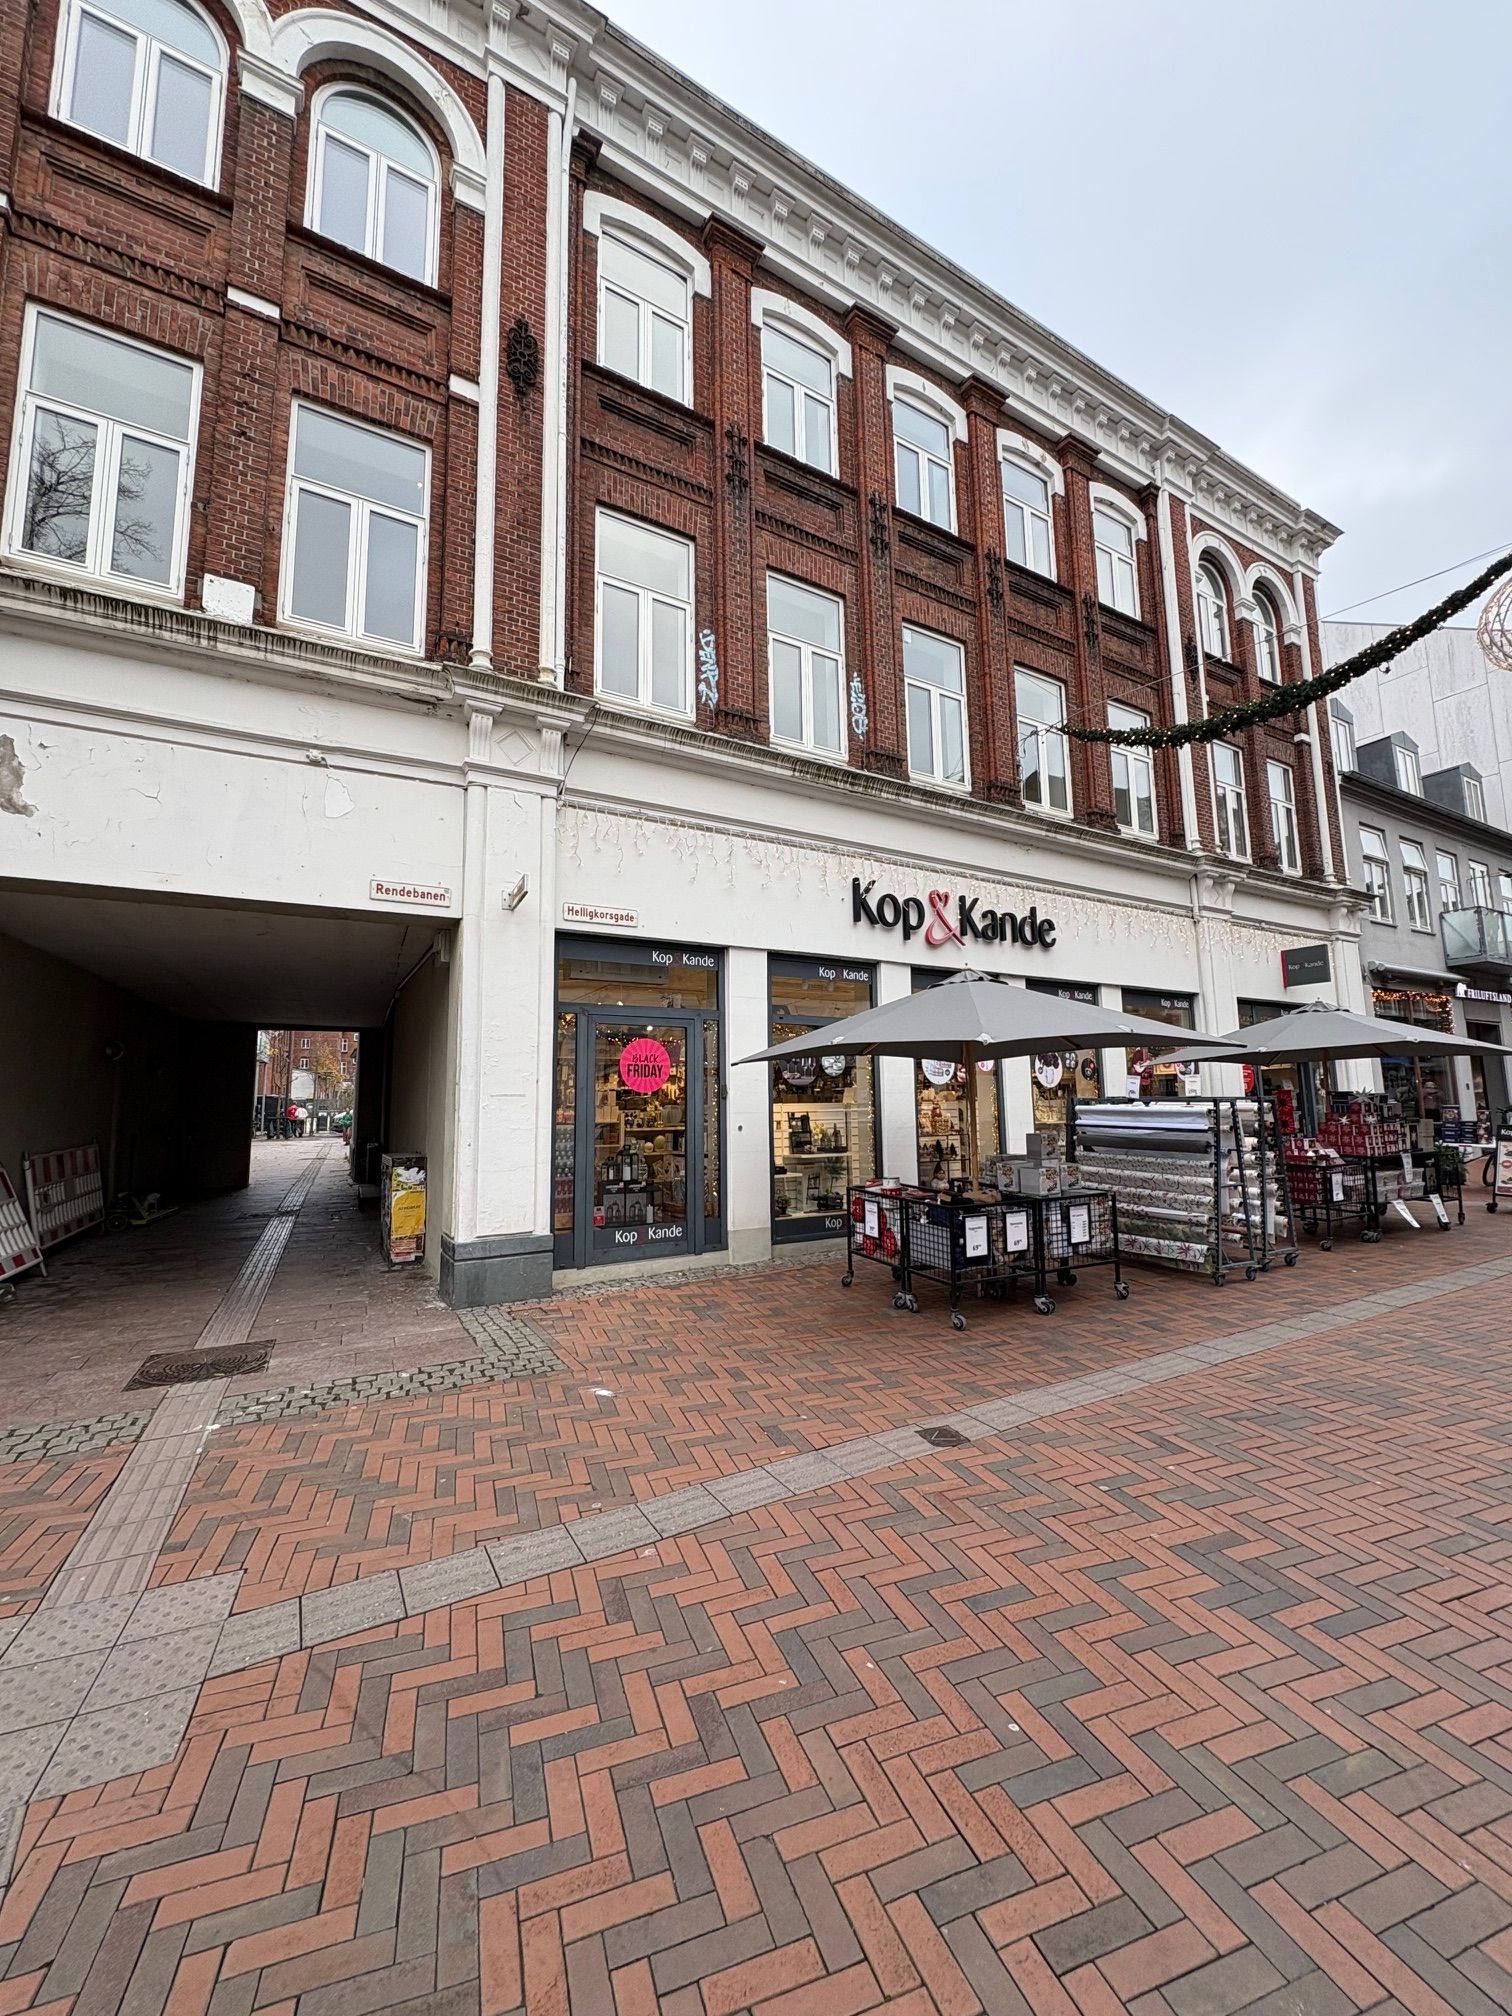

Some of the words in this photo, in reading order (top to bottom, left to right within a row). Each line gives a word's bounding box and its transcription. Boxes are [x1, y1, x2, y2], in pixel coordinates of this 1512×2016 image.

[376, 883, 446, 902] Rendebanen
[567, 905, 635, 923] Helligkorsgade
[652, 950, 673, 966] Kop
[682, 953, 714, 967] Kande
[819, 966, 836, 980] Kop
[843, 969, 868, 981] Kande
[1467, 988, 1512, 1004] FRILUFTSLAND
[632, 1054, 659, 1064] BLACK
[626, 1064, 663, 1078] FRIDAY
[825, 1216, 843, 1230] Kop
[615, 1230, 638, 1244] Kop
[648, 1224, 683, 1240] Kande
